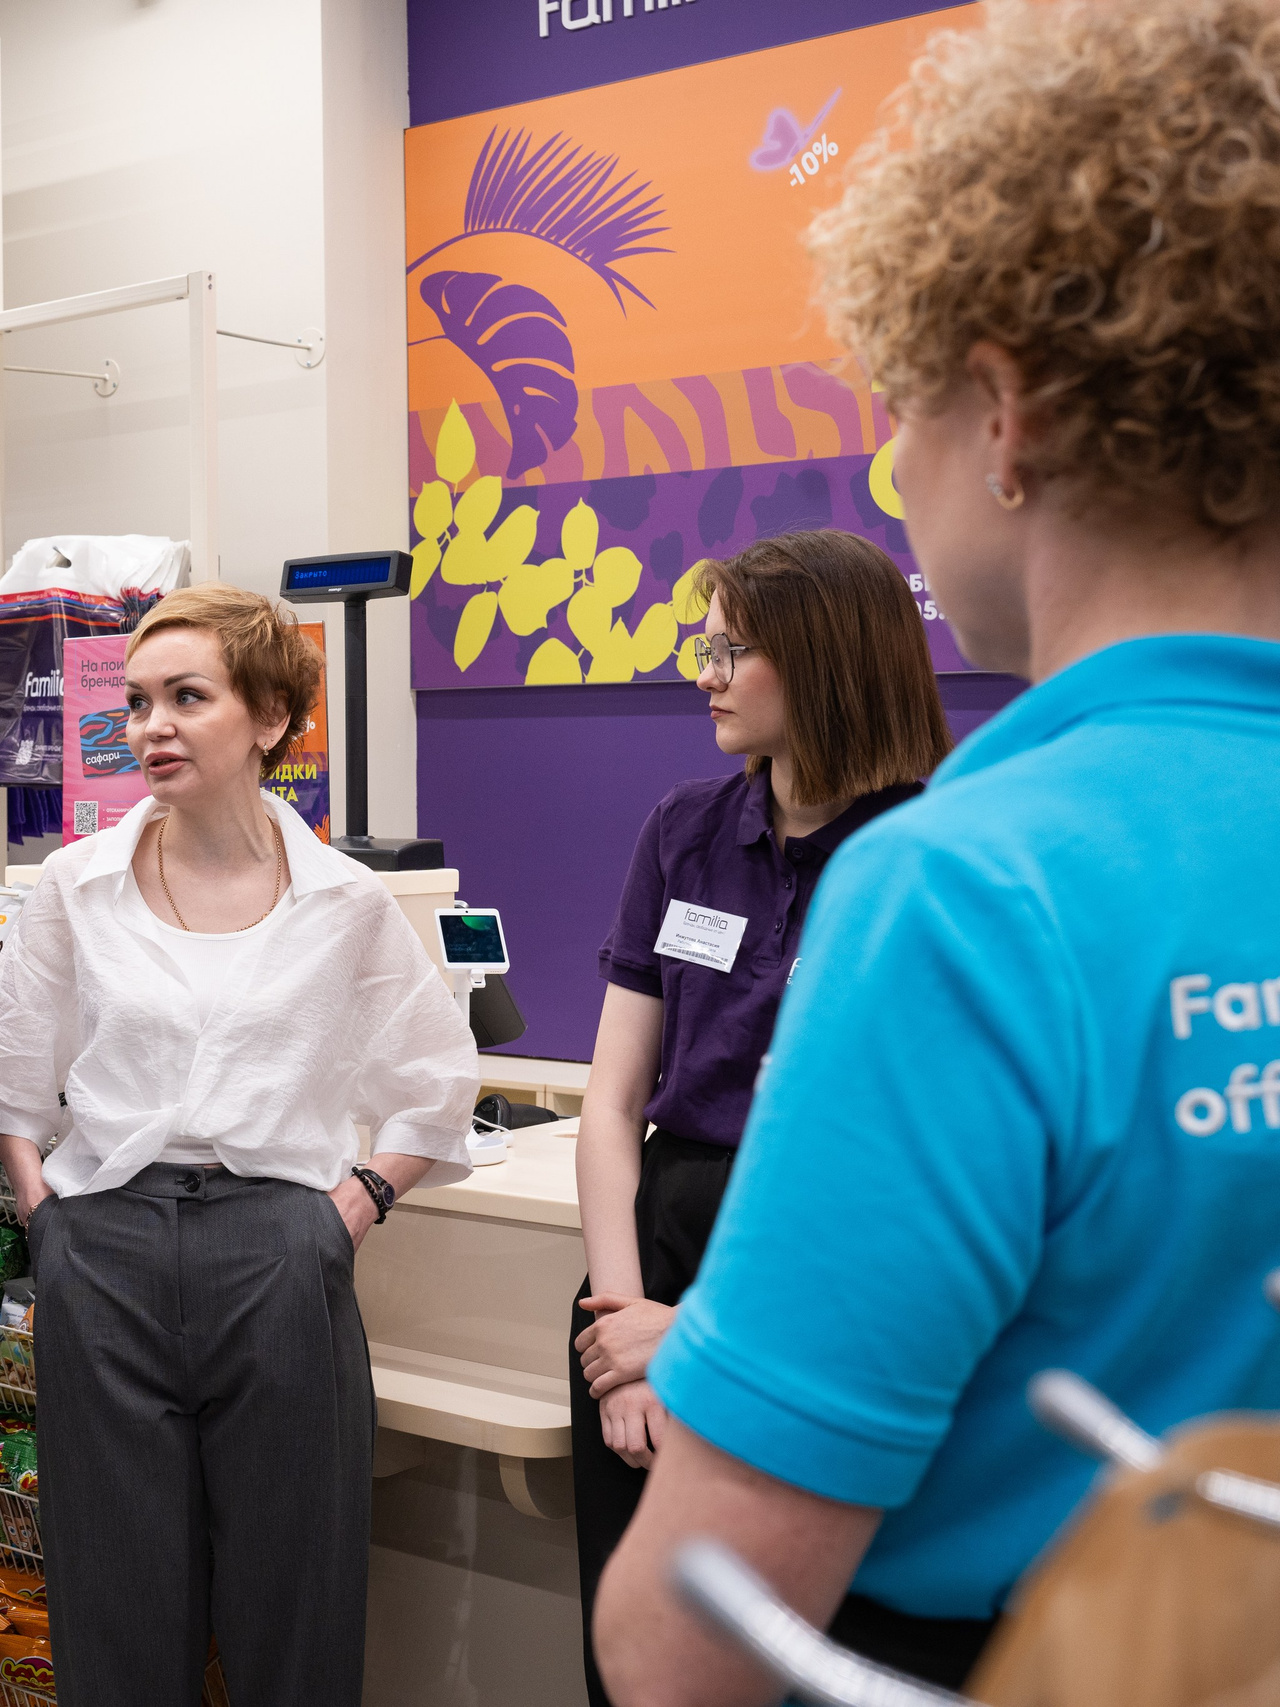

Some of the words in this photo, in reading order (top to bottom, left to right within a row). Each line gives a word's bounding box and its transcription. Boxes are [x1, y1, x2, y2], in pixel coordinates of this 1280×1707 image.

[789, 132, 839, 187] -10%
[81, 660, 98, 672] На
[85, 750, 121, 765] сафари
[265, 763, 318, 783] ИДКИ
[684, 907, 729, 930] familia
